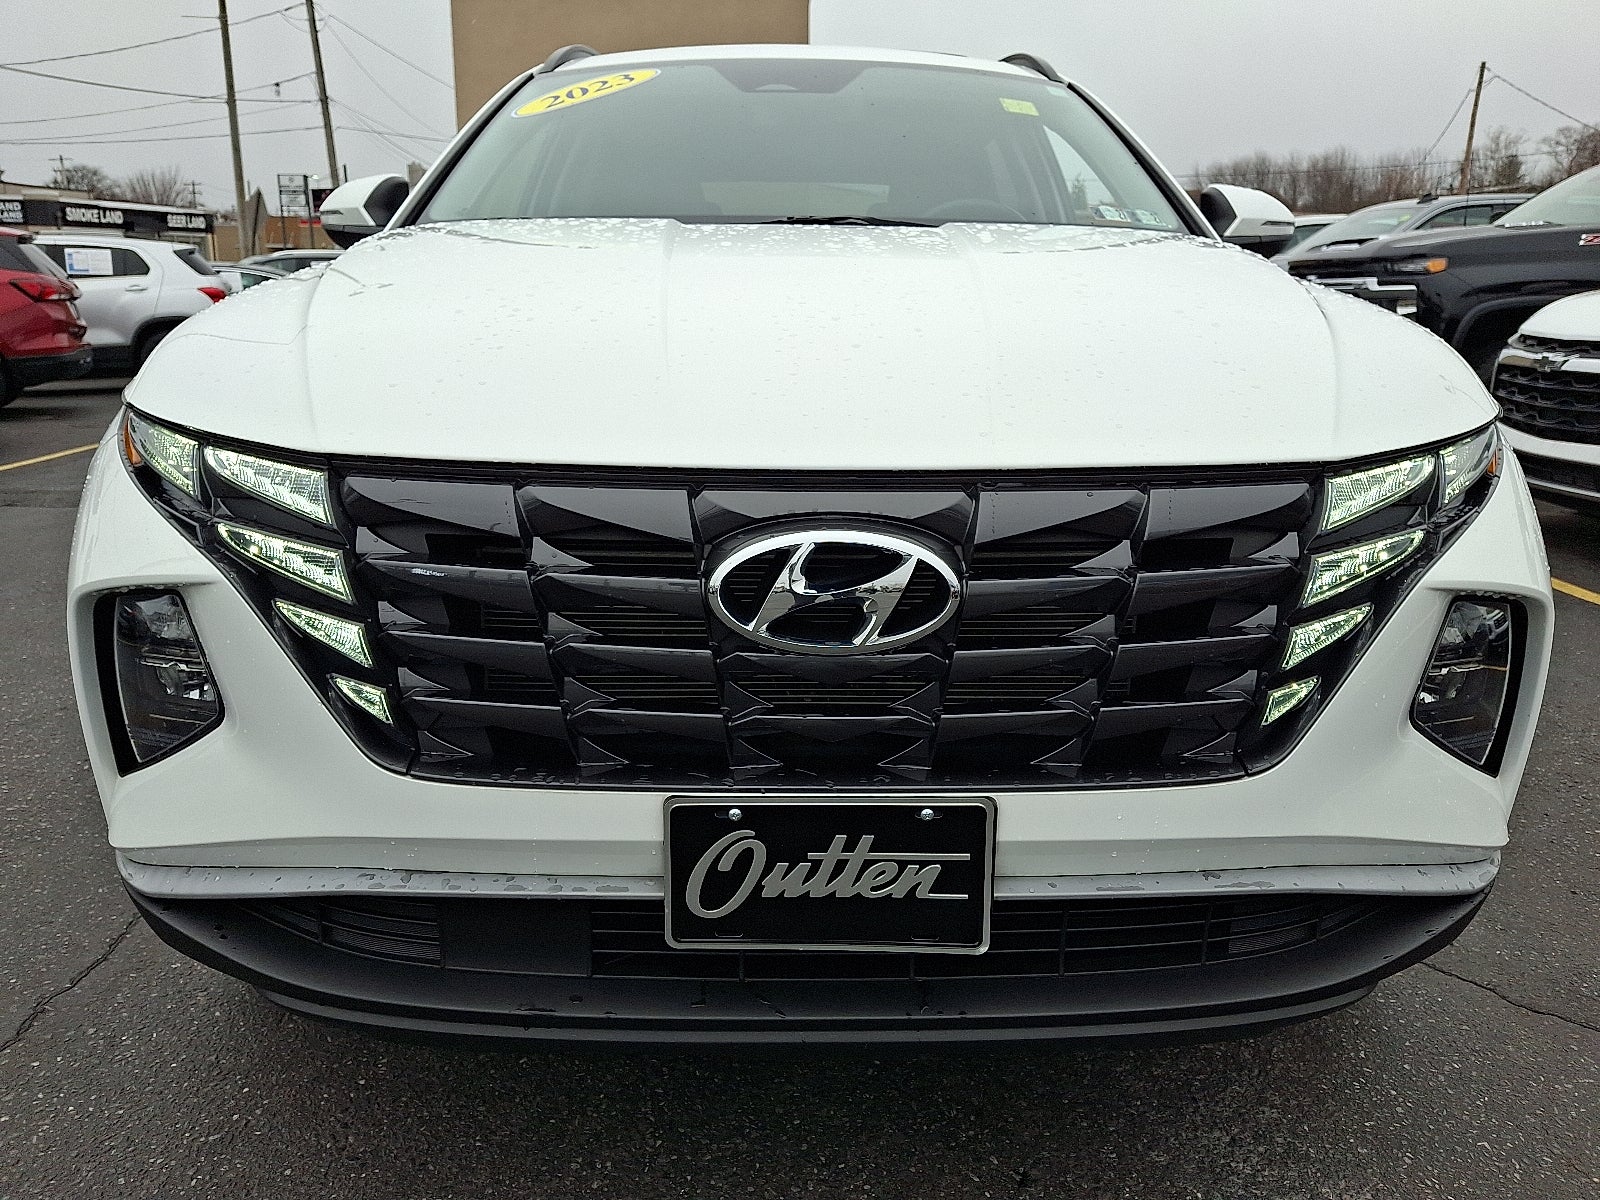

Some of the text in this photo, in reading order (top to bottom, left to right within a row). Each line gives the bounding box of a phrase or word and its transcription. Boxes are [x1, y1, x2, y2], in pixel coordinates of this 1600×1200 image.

[541, 74, 635, 108] 2023
[65, 206, 124, 224] SMOKE LAND
[167, 213, 206, 229] BEER LAND
[686, 829, 971, 919] Outten
